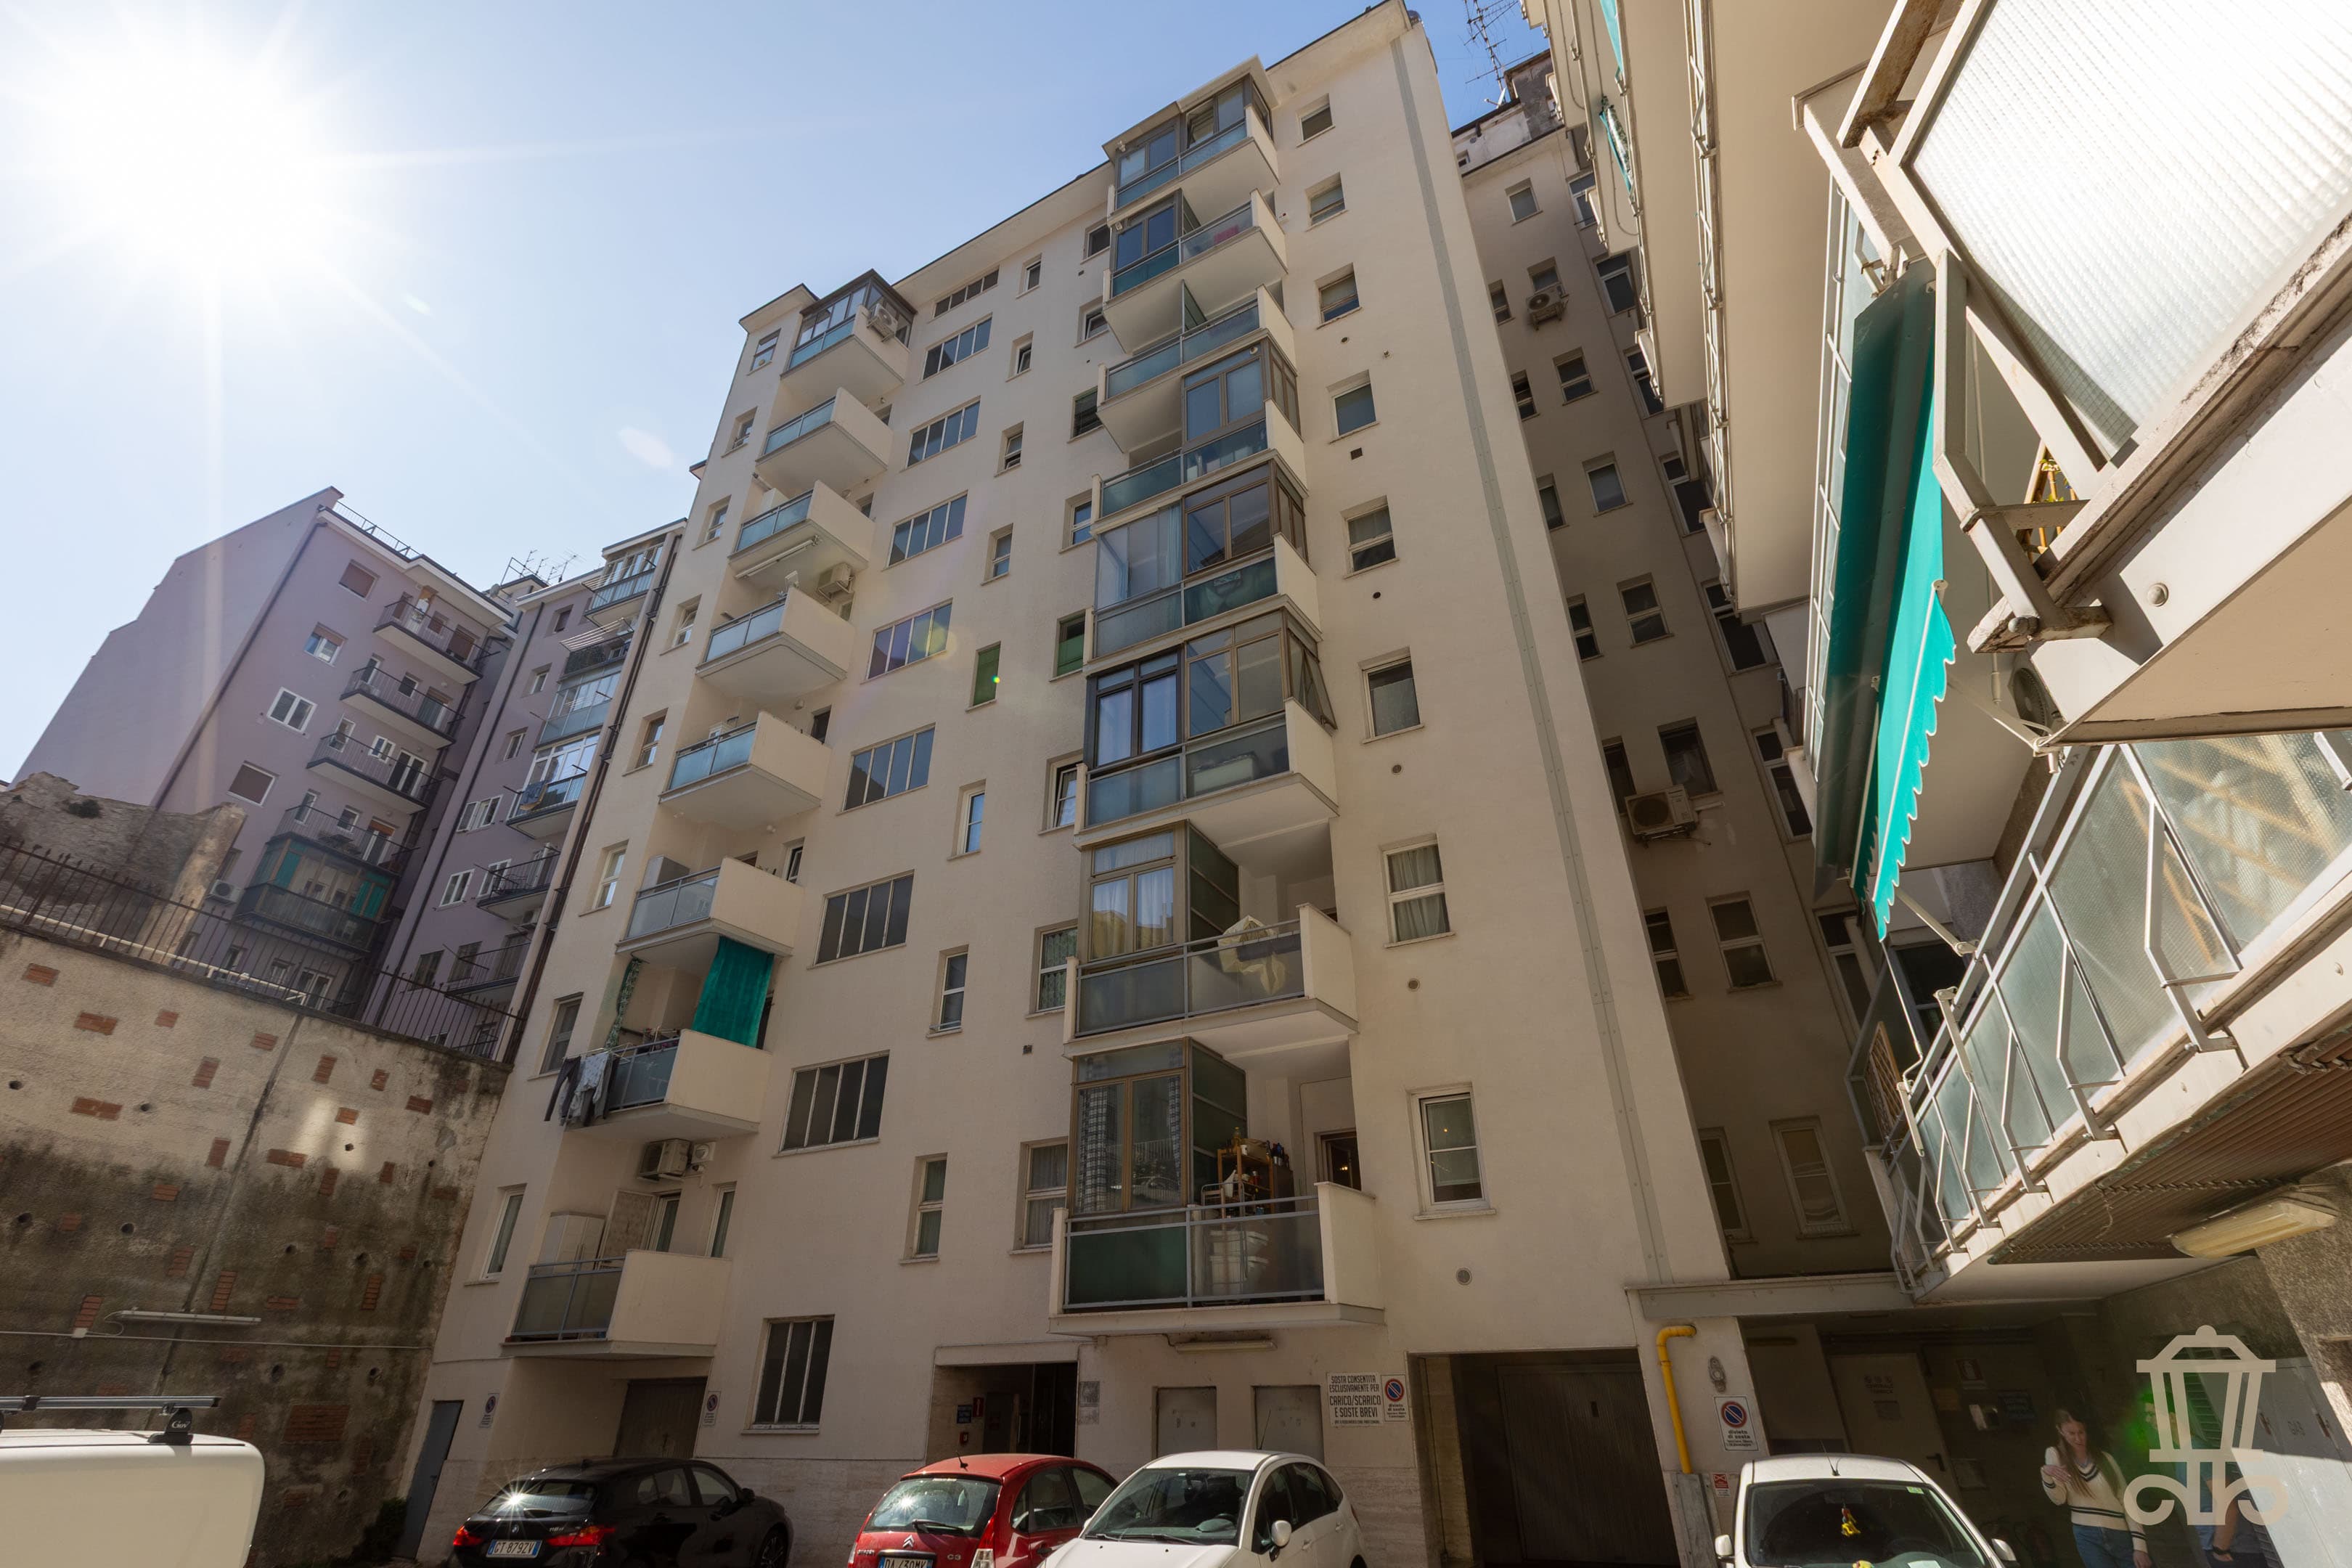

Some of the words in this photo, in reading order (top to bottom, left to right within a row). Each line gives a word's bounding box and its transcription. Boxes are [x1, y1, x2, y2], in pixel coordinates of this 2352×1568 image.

[1331, 1375, 1347, 1384] SOSTA
[1347, 1375, 1376, 1384] CONSENTITA
[1329, 1384, 1369, 1392] ESCLUSIVAMENTE
[1329, 1395, 1381, 1406] CARICO/SCARICO
[1334, 1408, 1339, 1418] E
[1340, 1408, 1359, 1418] SOSTE
[1360, 1407, 1378, 1418] BREVI
